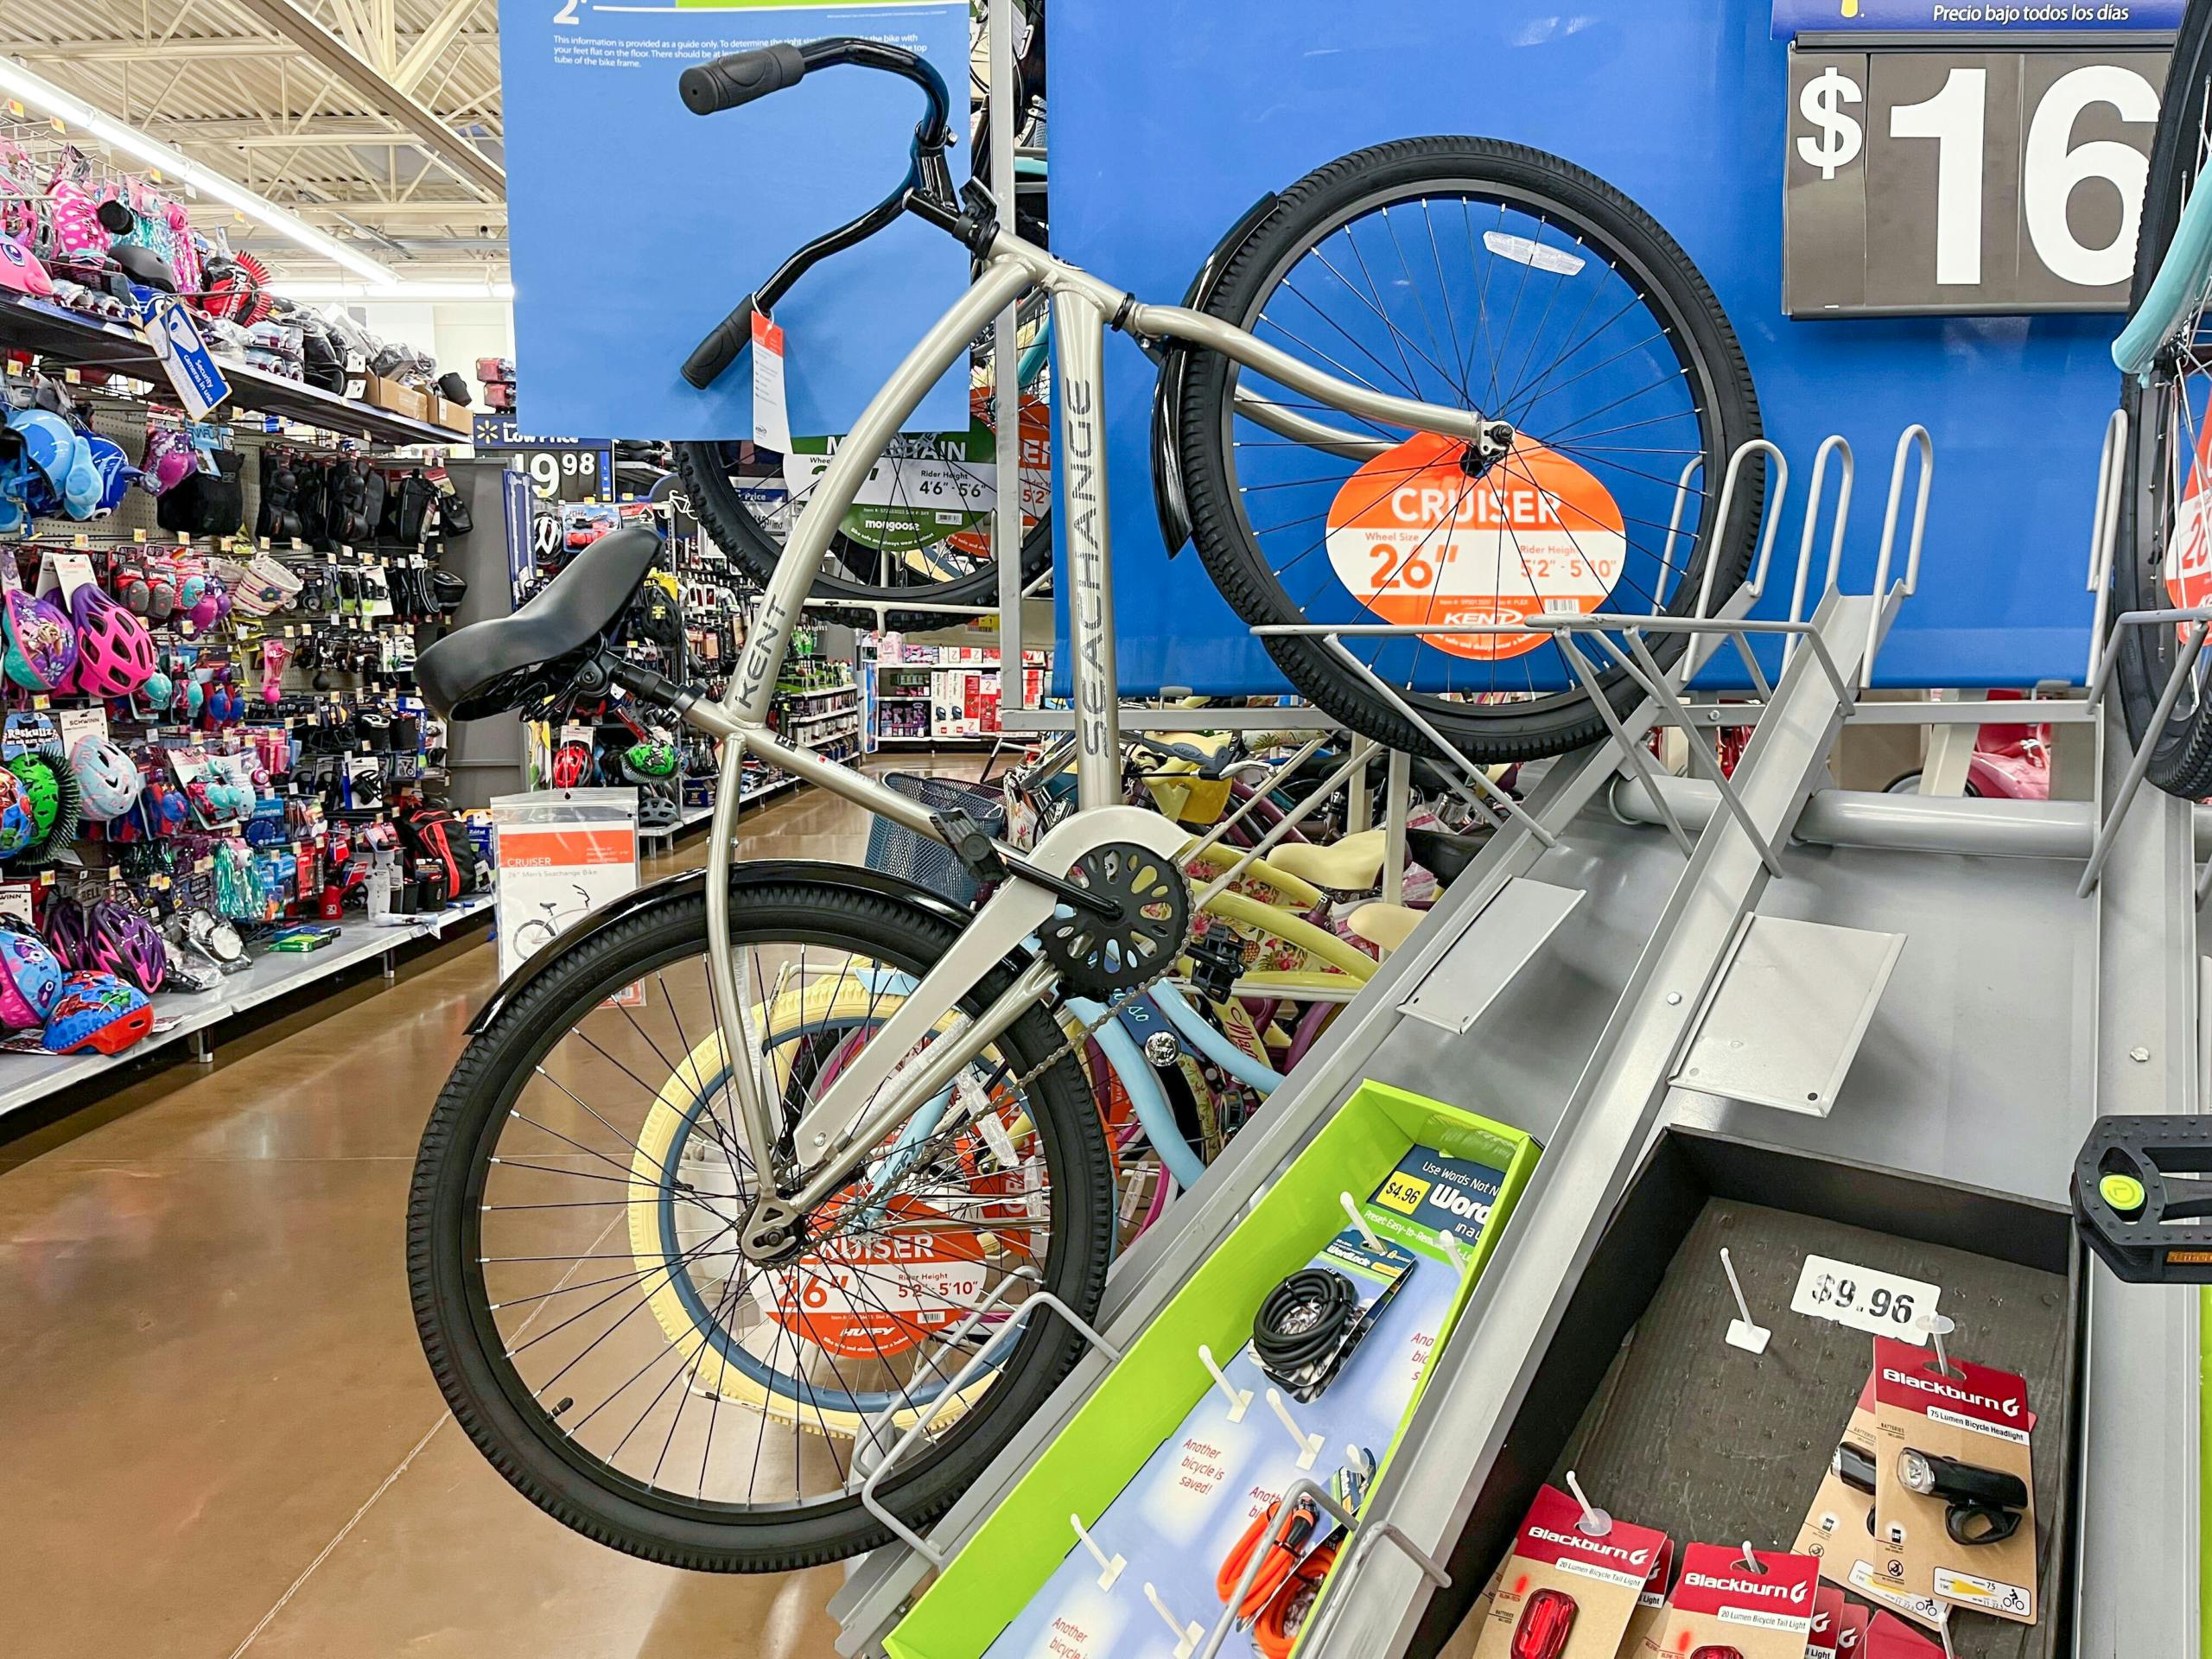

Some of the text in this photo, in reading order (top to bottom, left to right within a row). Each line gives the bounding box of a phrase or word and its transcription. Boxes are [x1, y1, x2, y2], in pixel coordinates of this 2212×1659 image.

[1933, 4, 2129, 25] Precio bajo todos los días
[553, 35, 569, 44] This
[571, 37, 617, 47] information
[626, 40, 659, 48] provided
[677, 41, 700, 50] guide
[701, 41, 718, 49] only.
[730, 39, 769, 48] determine
[900, 34, 918, 42] with
[553, 47, 571, 55] your
[573, 47, 588, 55] feet
[590, 48, 603, 56] flat
[631, 49, 650, 58] floor.
[651, 49, 673, 58] There
[674, 49, 700, 58] should
[702, 49, 712, 58] be
[584, 57, 597, 66] the
[599, 58, 616, 67] bike
[617, 59, 641, 67] frame.
[183, 355, 201, 382] cameras
[195, 359, 213, 388] Security
[562, 452, 595, 475] 98
[920, 470, 969, 480] Rider Height
[1391, 487, 1562, 524] CRUISER
[865, 520, 920, 532] mongoose
[1365, 531, 1419, 542] Wheel Size
[1521, 545, 1577, 556] Rider Heigh
[1066, 377, 1108, 759] SEACHANGE
[1370, 543, 1459, 589] 26"
[1444, 612, 1515, 625] KENT
[735, 594, 785, 709] KENT
[69, 717, 100, 727] SCHWINN
[7, 728, 53, 740] Raskullz
[507, 858, 552, 867] CRUISER
[543, 870, 581, 879] Seachange
[81, 887, 102, 900] BELL
[1422, 1161, 1440, 1175] Use
[1440, 1168, 1470, 1185] Words
[1470, 1178, 1489, 1192] Not
[1386, 1182, 1421, 1205] $4.96
[1363, 1210, 1388, 1224] Preset:
[1455, 1223, 1466, 1232] in
[922, 1272, 949, 1281] Height
[1812, 1274, 1915, 1324] $9.96
[840, 1326, 896, 1337] HUFFY
[1883, 1368, 1999, 1410] Blackburn
[1930, 1409, 2024, 1441] 75 Lumen Bicycle Headlight
[1183, 1438, 1222, 1459] Another
[1181, 1455, 1224, 1480] bicycle is
[1179, 1476, 1213, 1495] saved!
[1529, 1527, 1628, 1560] Blackburn
[1568, 1561, 1588, 1573] Lumen
[1589, 1567, 1611, 1580] Bicycle
[1611, 1573, 1623, 1583] Tail
[1624, 1577, 1641, 1587] Light
[1685, 1573, 1788, 1599] Blackburn
[1986, 1582, 1996, 1591] 75
[1643, 1594, 1660, 1605] Light
[1730, 1611, 1751, 1622] Lumen
[1752, 1615, 1776, 1627] Bicycle
[1789, 1620, 1806, 1630] Light
[1052, 1617, 1088, 1643] Another
[1810, 1647, 1831, 1659] Light
